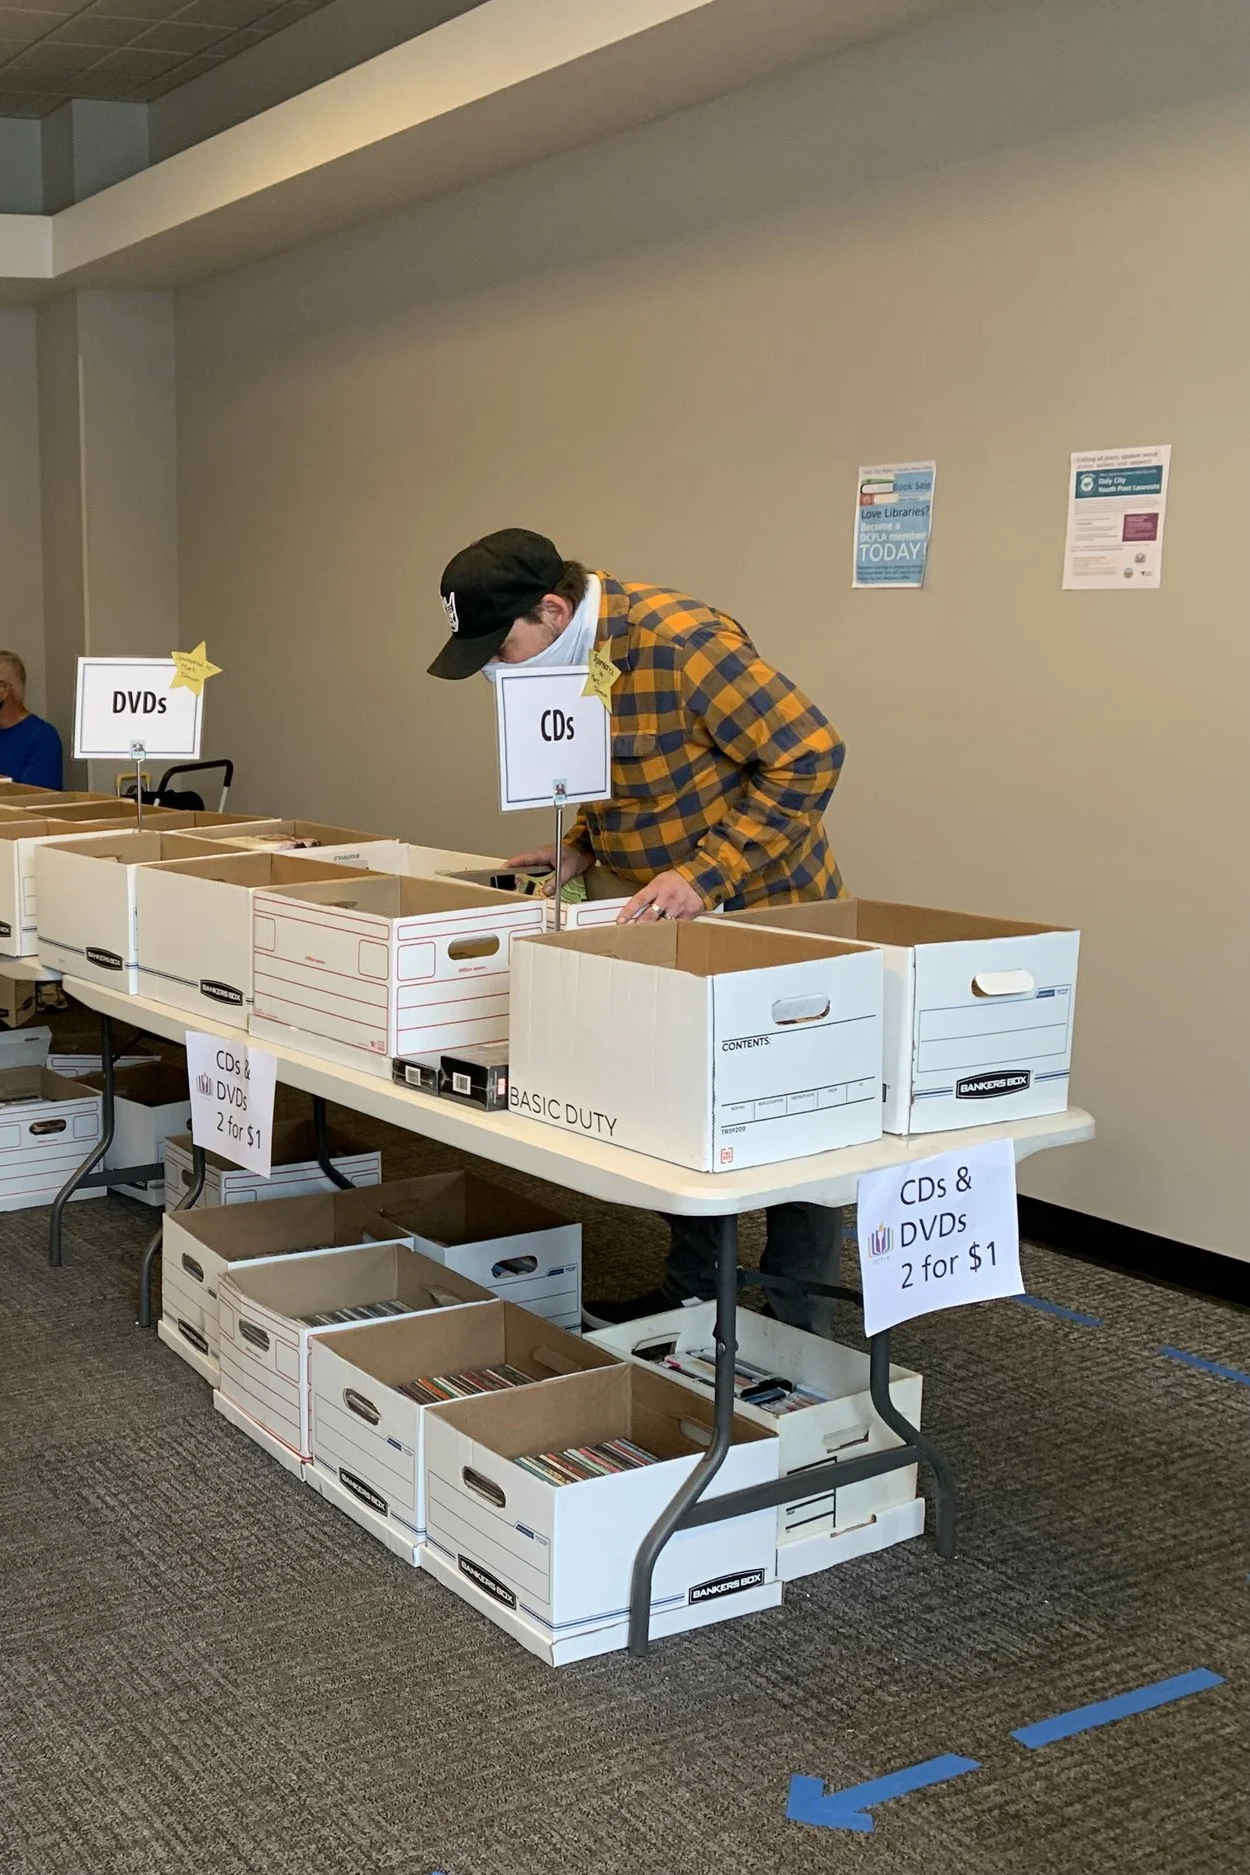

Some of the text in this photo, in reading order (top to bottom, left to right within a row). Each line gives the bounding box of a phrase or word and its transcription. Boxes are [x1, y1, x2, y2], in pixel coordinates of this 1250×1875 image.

[861, 522, 901, 531] Become a
[862, 505, 930, 519] Love Libraries?
[859, 541, 927, 562] TODAY!
[889, 532, 926, 541] member
[113, 691, 167, 714] DVDs
[541, 709, 575, 742] CDs
[202, 983, 241, 1001] BANKERS BOX
[722, 1037, 772, 1052] CONTENTS:
[216, 1050, 251, 1080] CDs &
[217, 1080, 247, 1111] DVDs
[960, 1076, 1027, 1094] BANKERS BOX
[510, 1086, 617, 1136] BASIC DUTY
[217, 1112, 261, 1149] 2 for $1
[901, 1166, 972, 1205] CDs &
[901, 1212, 967, 1248] DVDs
[901, 1241, 996, 1289] 2 for $1
[341, 1474, 387, 1511] BANKERS BOX
[461, 1560, 514, 1604] BANKERS BOX
[693, 1574, 762, 1599] BANKERS BOX
